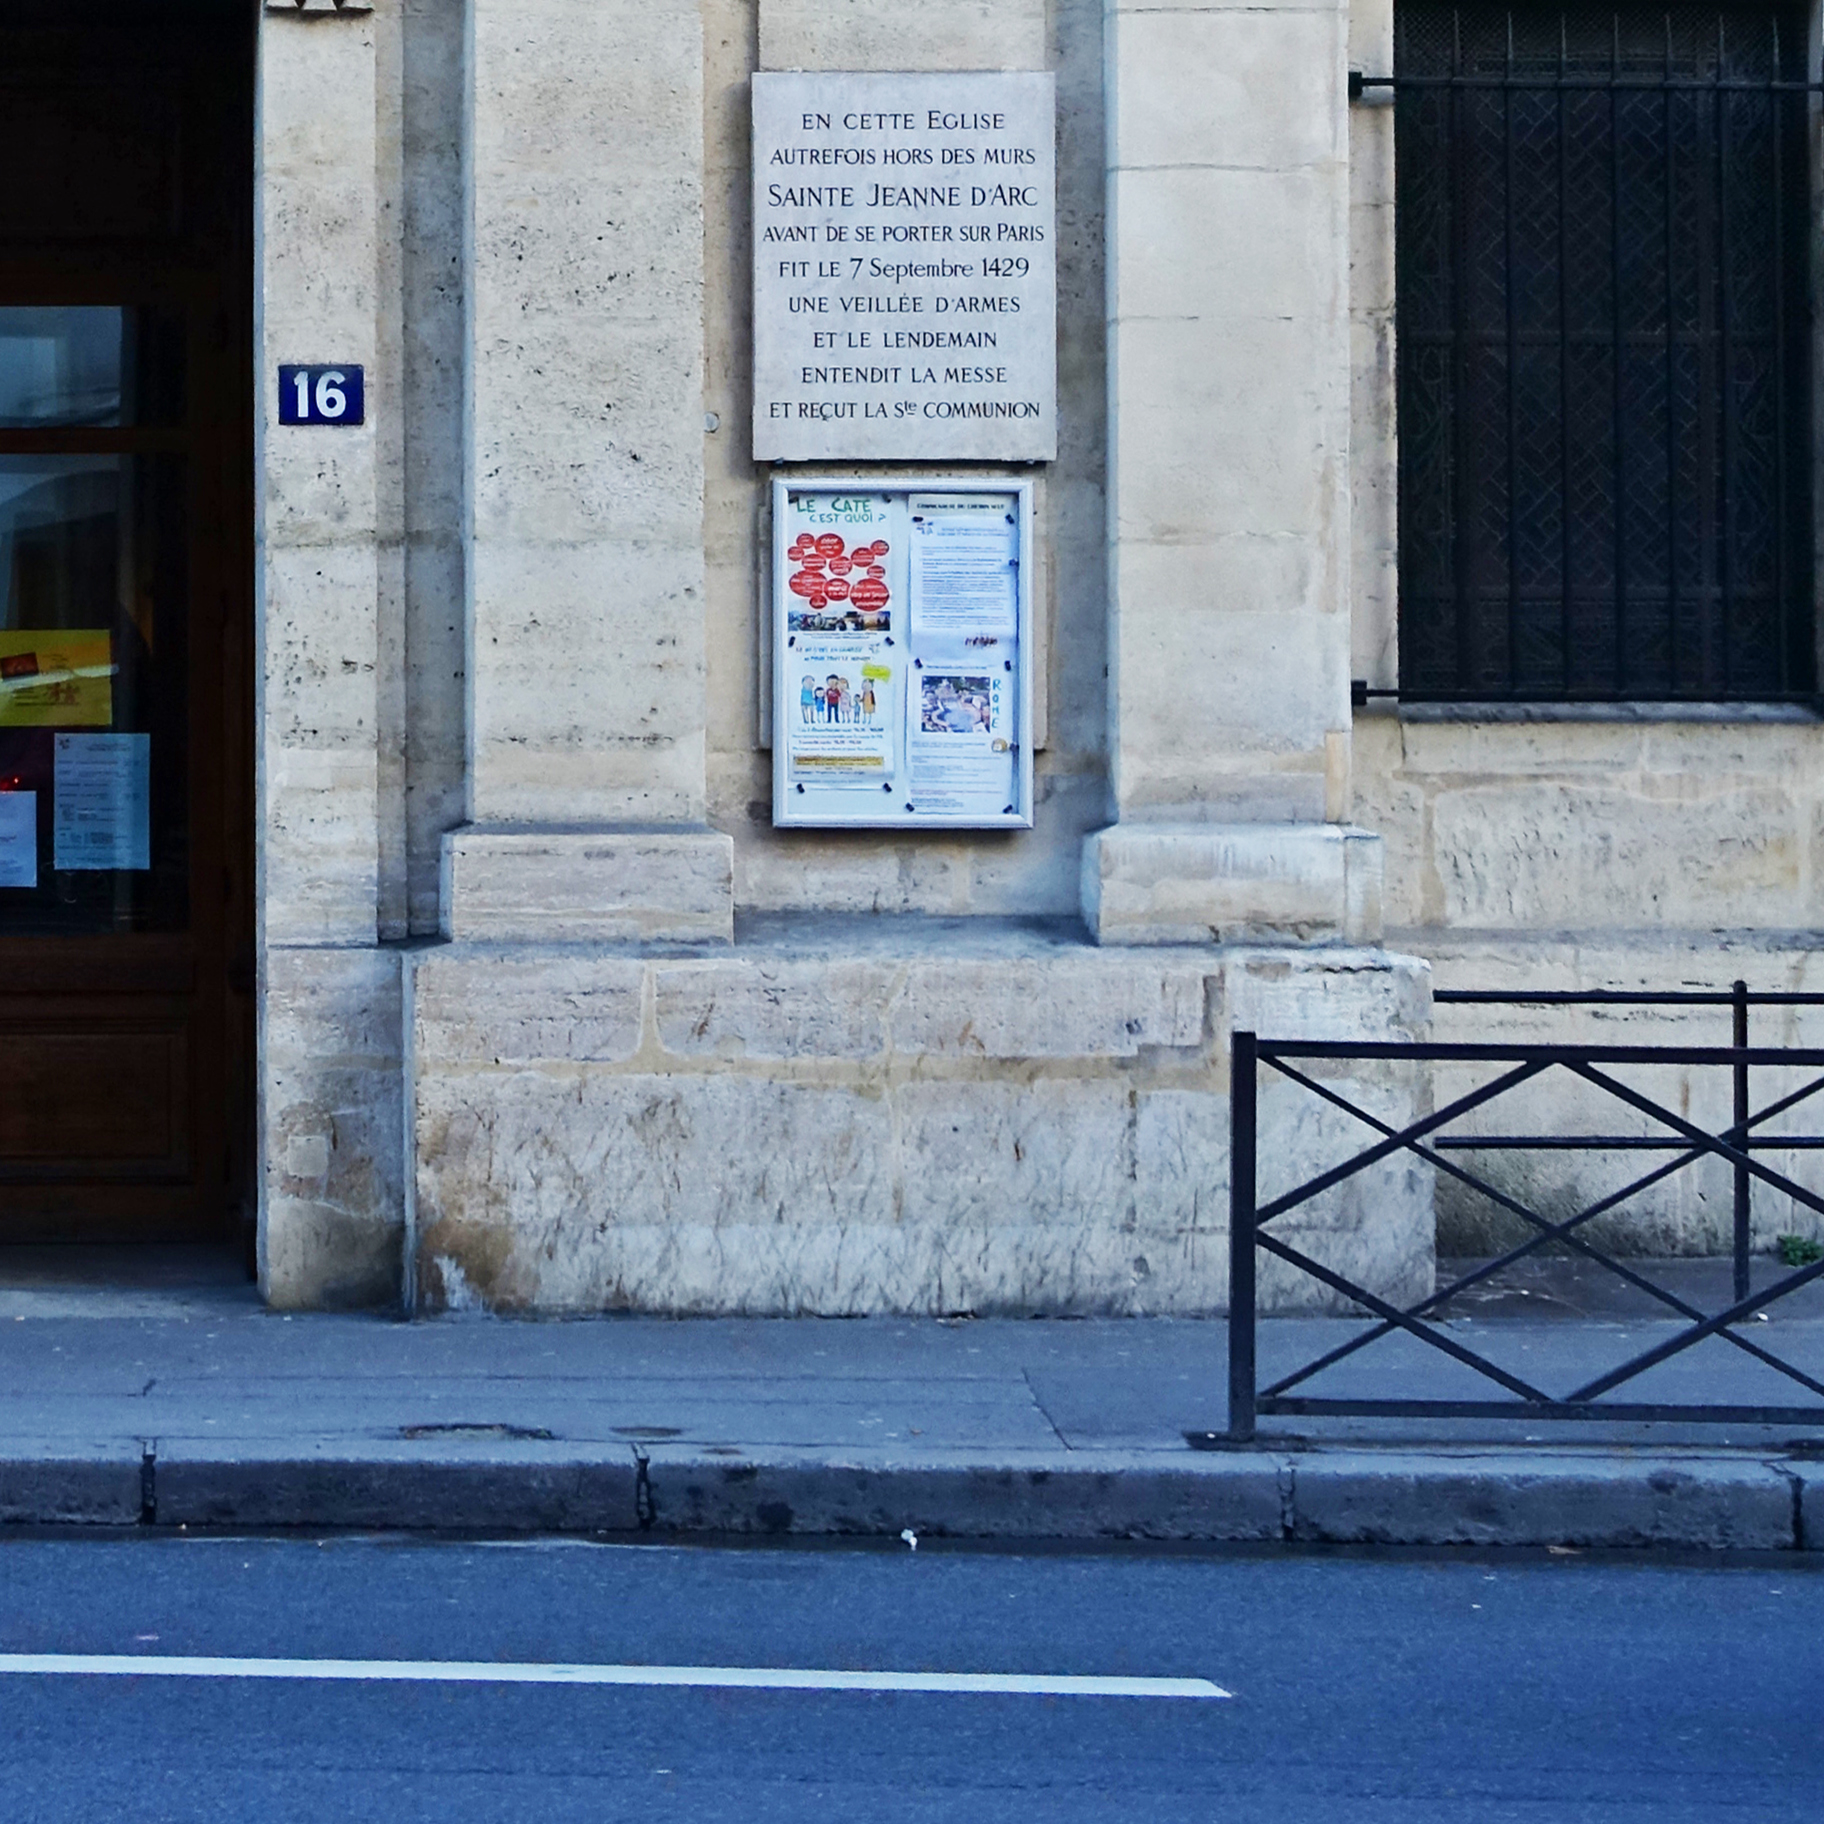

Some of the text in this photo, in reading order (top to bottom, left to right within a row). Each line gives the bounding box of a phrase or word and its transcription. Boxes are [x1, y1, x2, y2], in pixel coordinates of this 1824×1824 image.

[803, 111, 1004, 129] EN CETTE EGLISE
[771, 149, 1035, 164] AUTREFOIS HORS DES MURS
[763, 223, 1044, 242] AVANT DE SE PORTER SUR PARIS
[780, 258, 1029, 284] FIT LE 7 Septembre 1429
[790, 294, 1020, 312] UNE VEILLÉE D'ARMES
[814, 332, 996, 348] ET LE LENDEMAIN
[803, 367, 1006, 383] ENTENDIT LA MESSE
[294, 371, 346, 417] 16
[770, 403, 792, 418] ET
[799, 403, 857, 421] REÇUT
[865, 403, 887, 418] LA
[924, 402, 1039, 418] COMMUNION
